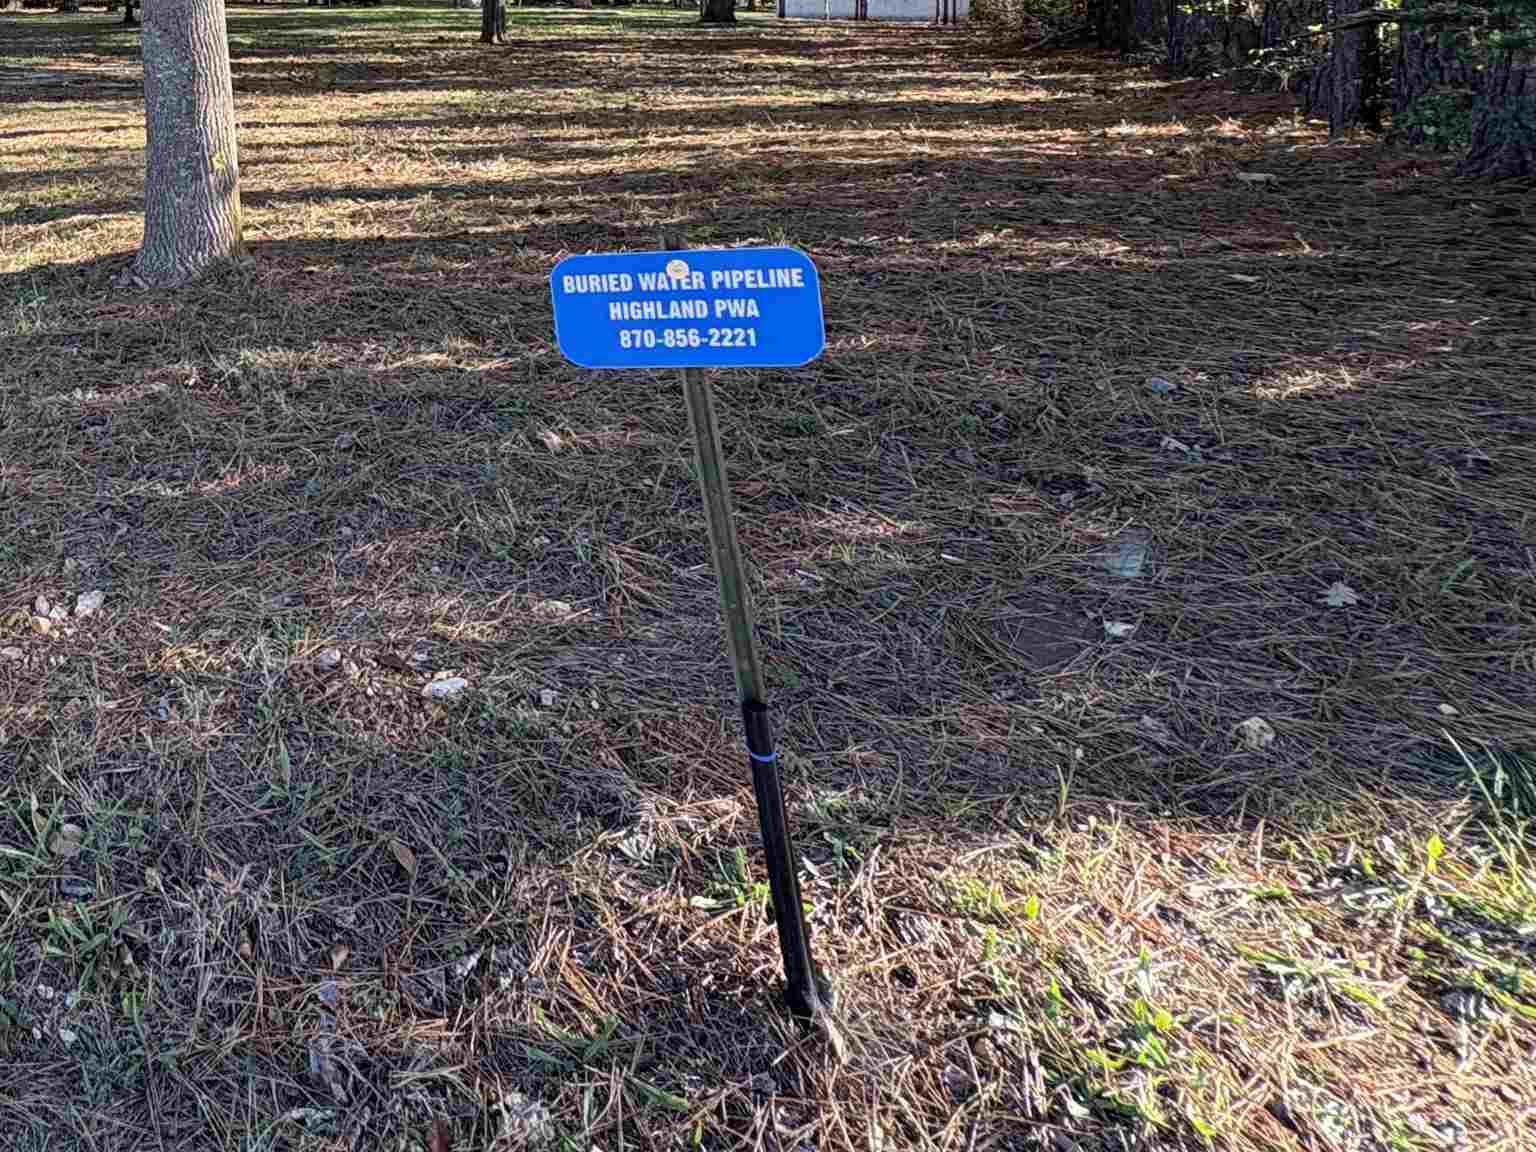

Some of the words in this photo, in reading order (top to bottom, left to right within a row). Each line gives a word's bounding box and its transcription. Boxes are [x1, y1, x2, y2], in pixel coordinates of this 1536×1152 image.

[563, 273, 633, 293] BURIED
[711, 268, 804, 290] PIPELINE
[609, 300, 708, 321] HIGHLAND
[714, 299, 760, 319] PWA
[619, 327, 757, 349] 870-856-2221
